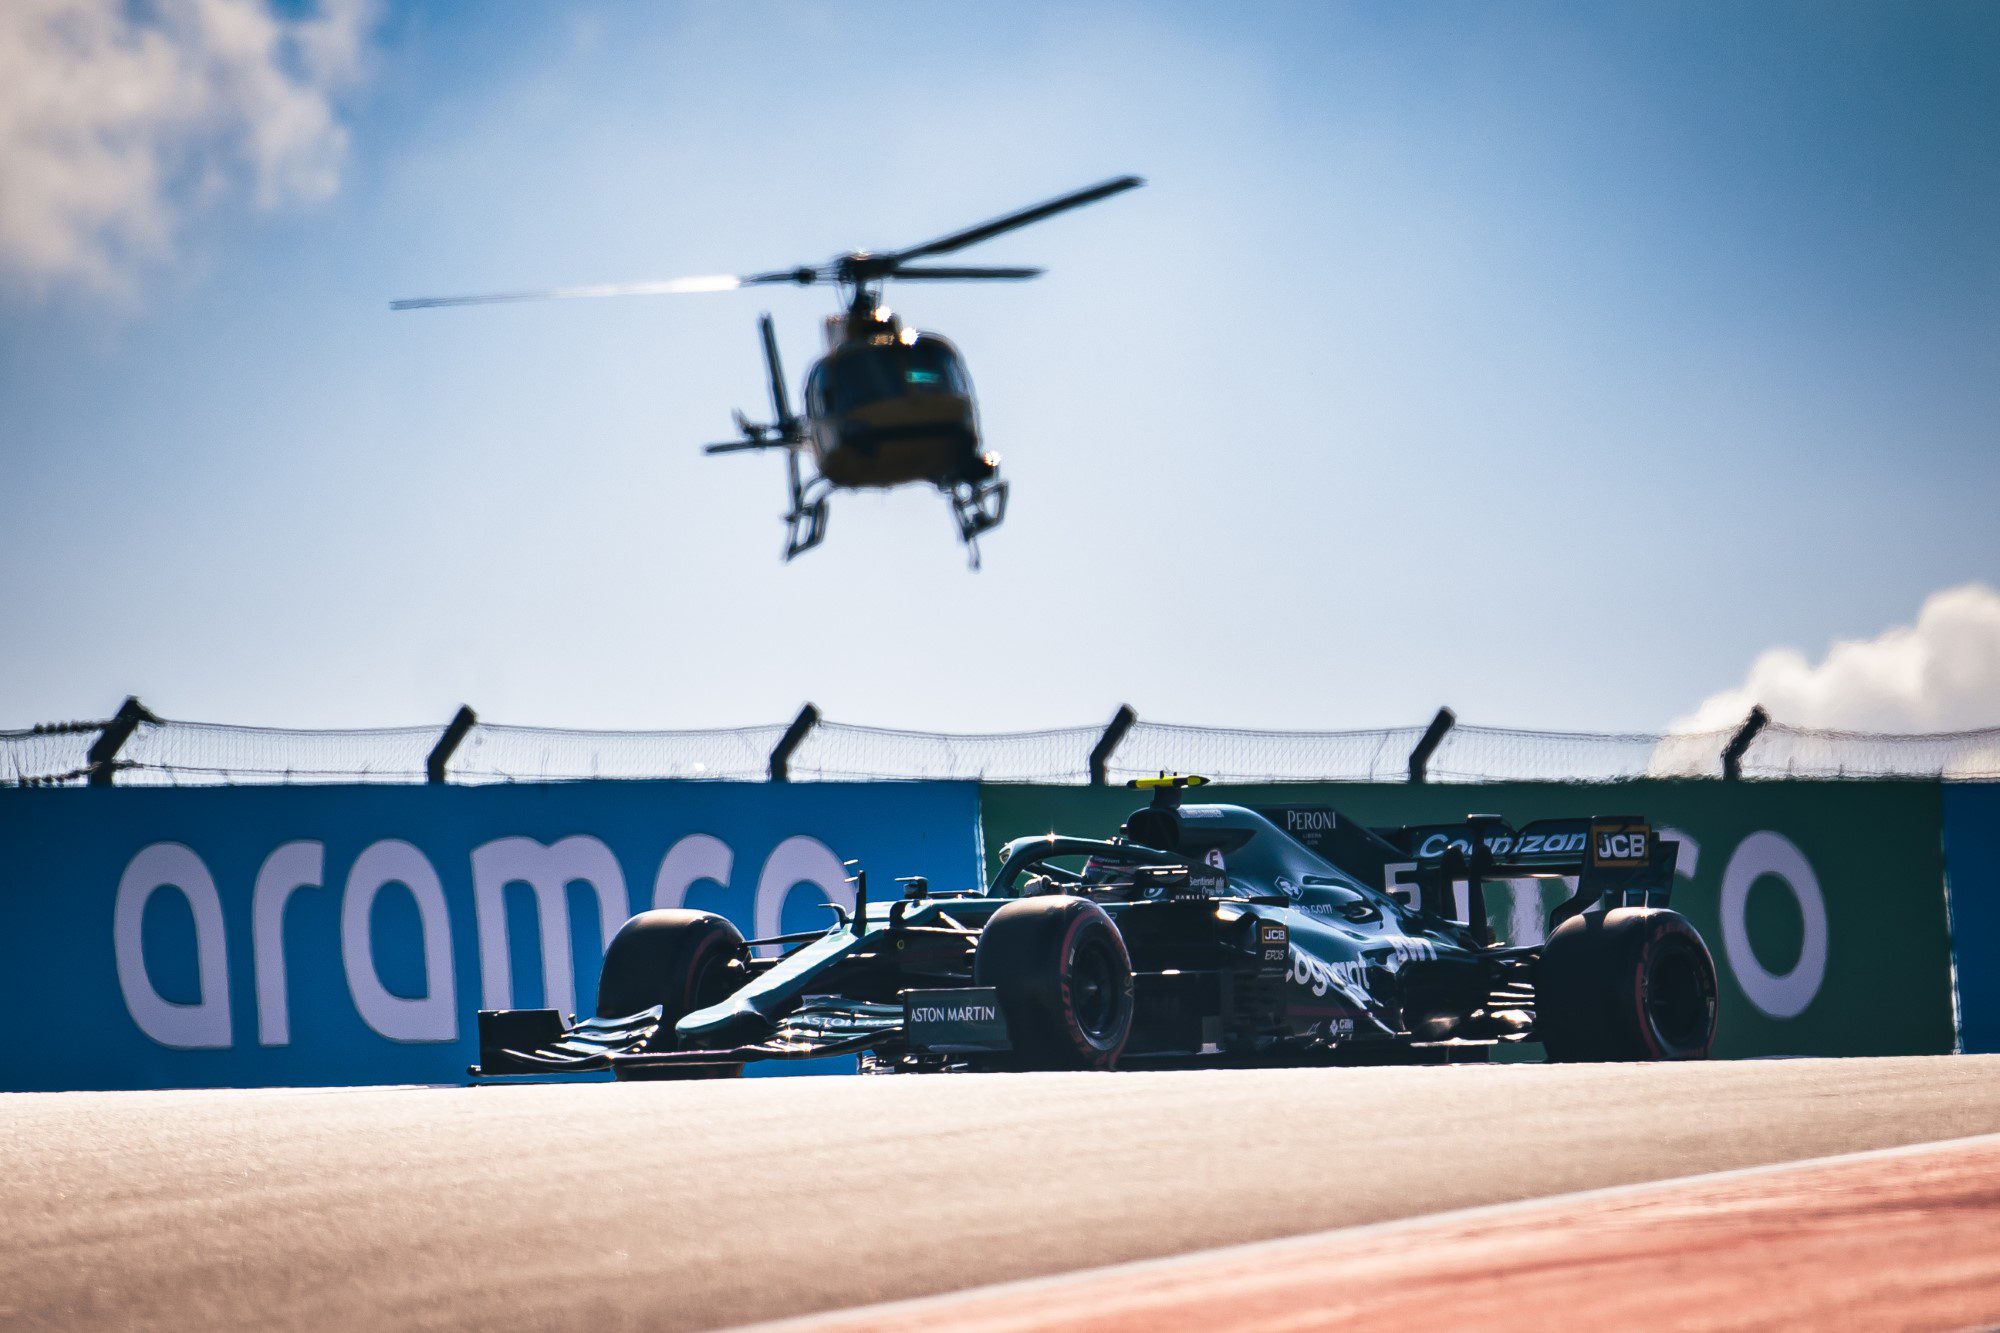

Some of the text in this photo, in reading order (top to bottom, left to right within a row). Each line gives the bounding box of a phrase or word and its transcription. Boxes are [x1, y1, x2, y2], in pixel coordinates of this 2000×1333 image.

[1287, 810, 1336, 830] PERONI
[1599, 834, 1646, 858] JCB
[1384, 862, 1422, 912] 5
[1264, 930, 1286, 941] JCB
[1264, 949, 1285, 960] EPOS
[911, 1006, 996, 1022] ASTON MARTIN
